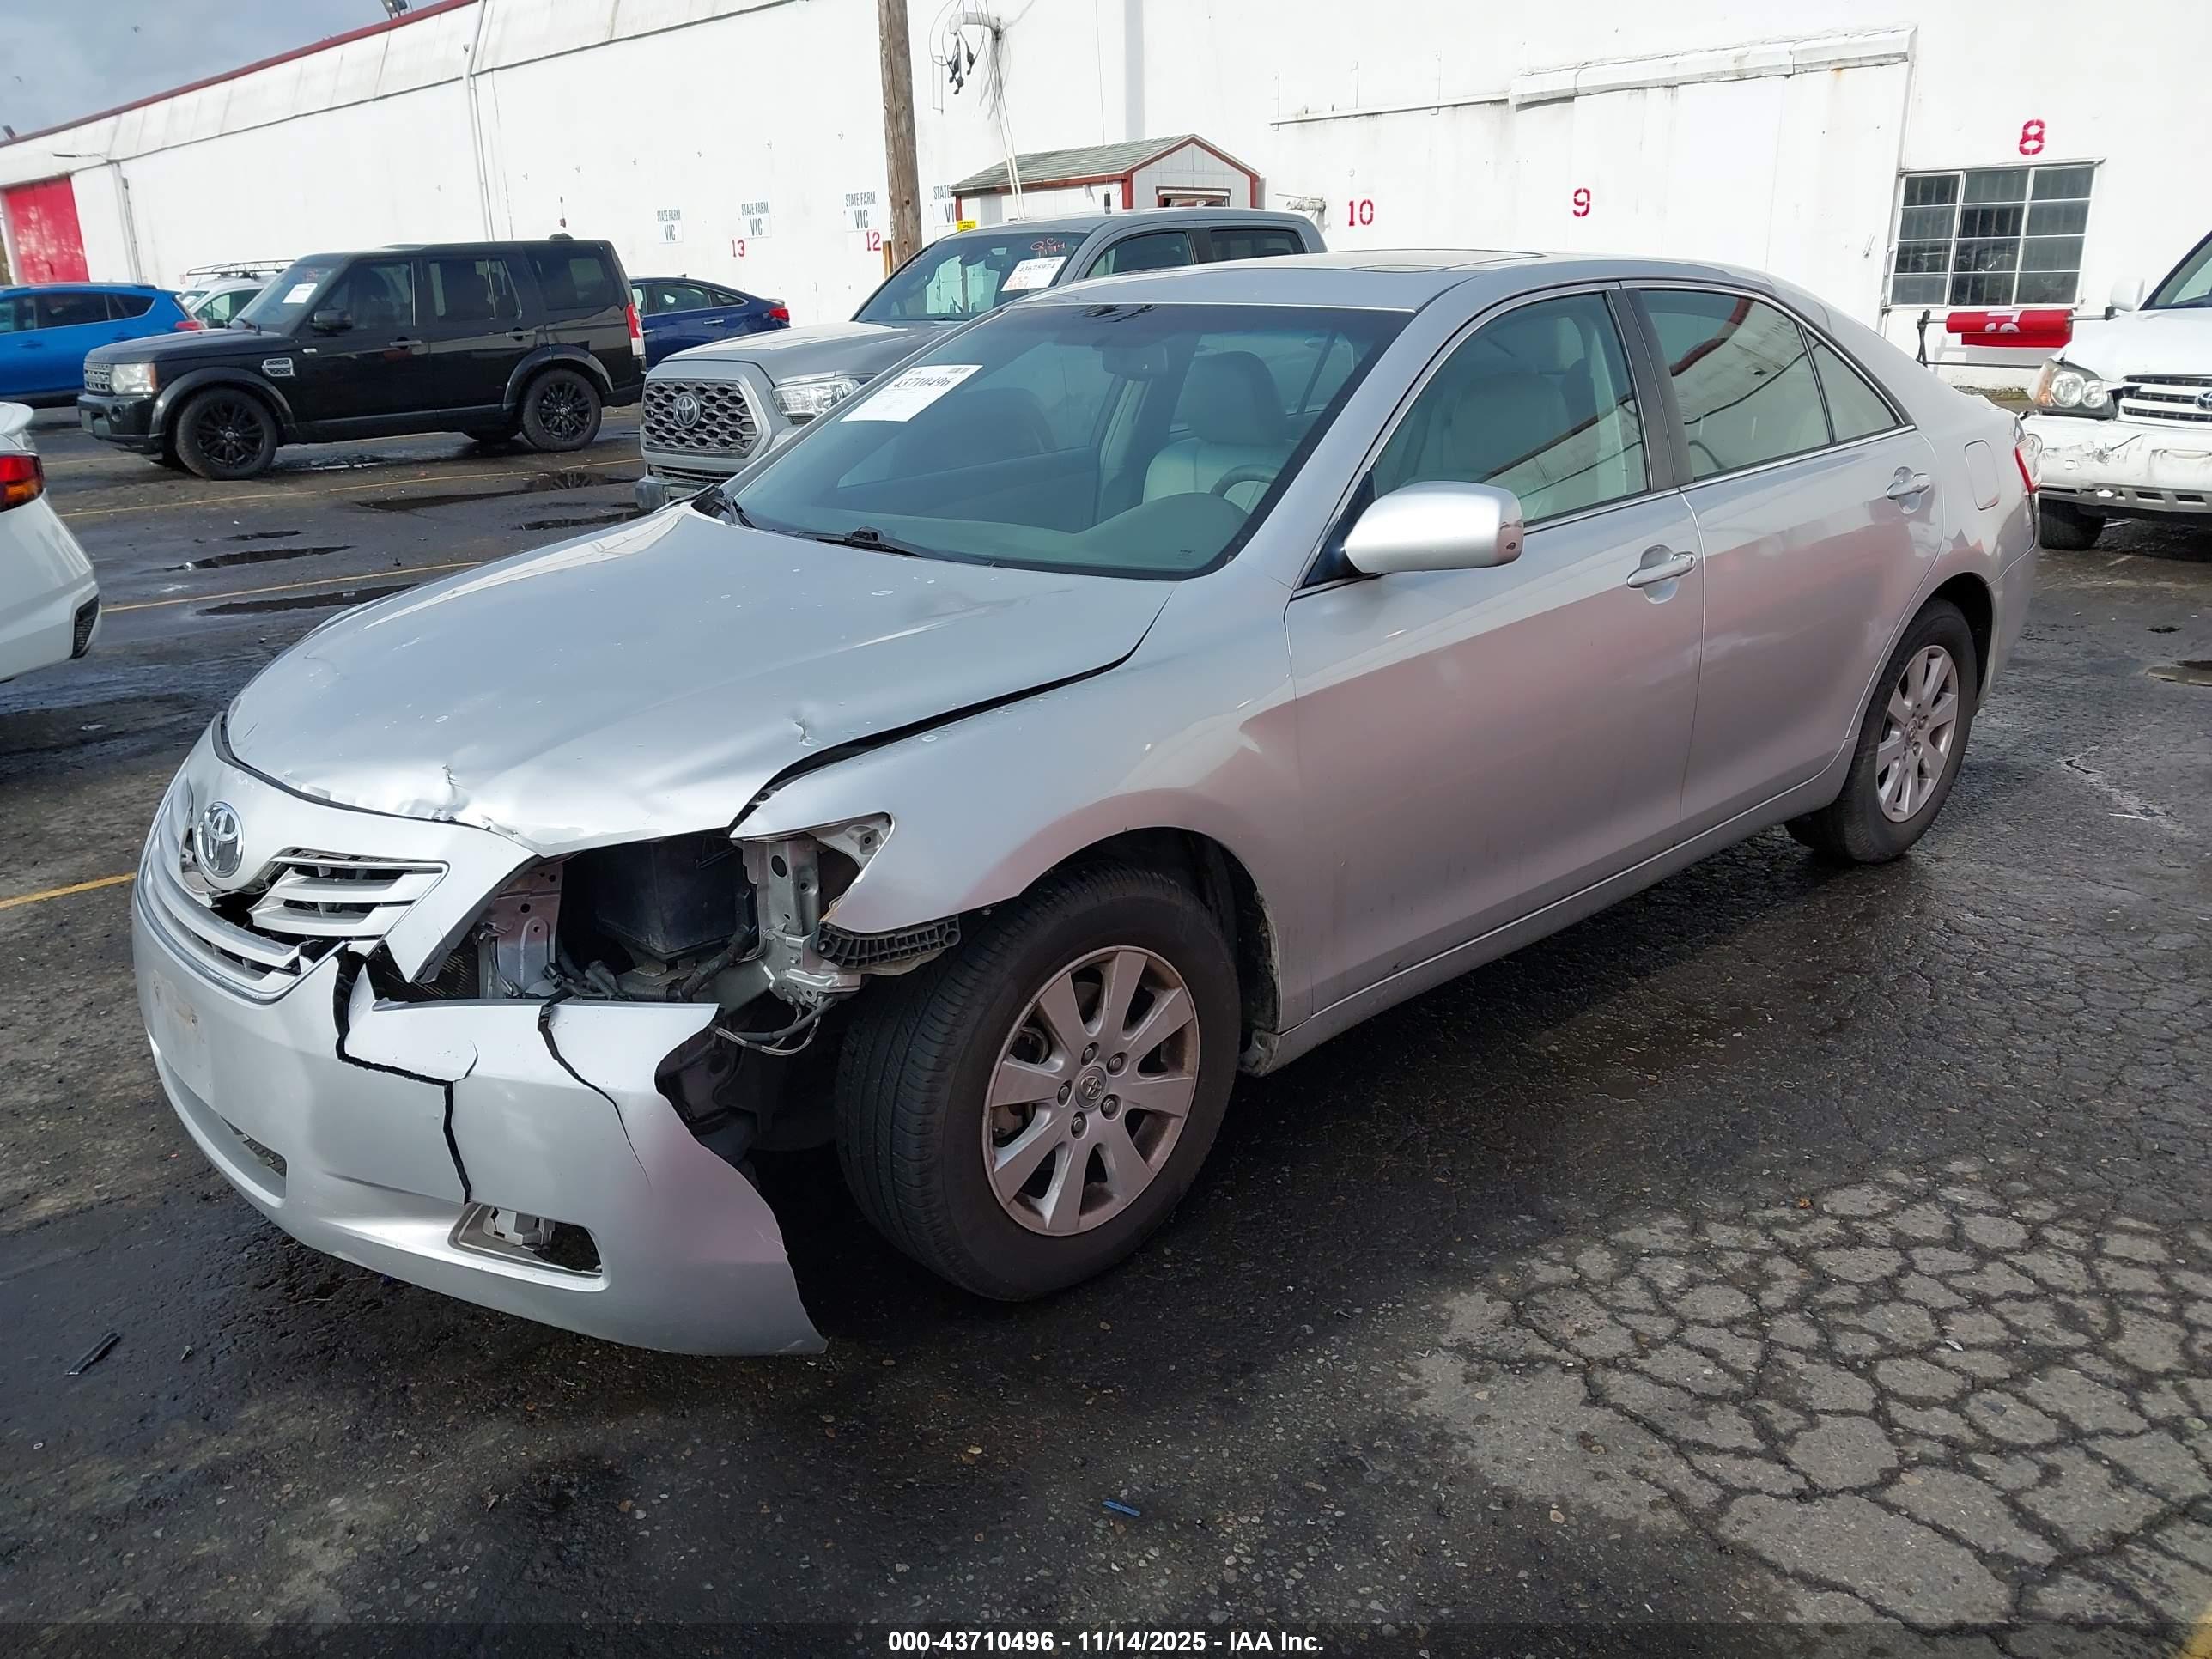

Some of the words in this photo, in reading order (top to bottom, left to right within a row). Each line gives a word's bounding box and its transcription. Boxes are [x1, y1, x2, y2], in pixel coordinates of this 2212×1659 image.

[2018, 119, 2045, 155] 8
[741, 204, 755, 216] STATE
[755, 201, 769, 215] FARM
[845, 193, 860, 207] STATE
[860, 191, 877, 206] FARM
[1572, 187, 1591, 217] 9
[656, 210, 669, 222] STATE
[668, 209, 681, 222] FARM
[854, 209, 869, 229] VIC
[944, 203, 955, 224] VI
[1348, 198, 1374, 227] 10
[664, 224, 676, 241] VIC
[750, 218, 763, 236] VIC
[732, 239, 745, 258] 13
[866, 231, 882, 252] 12
